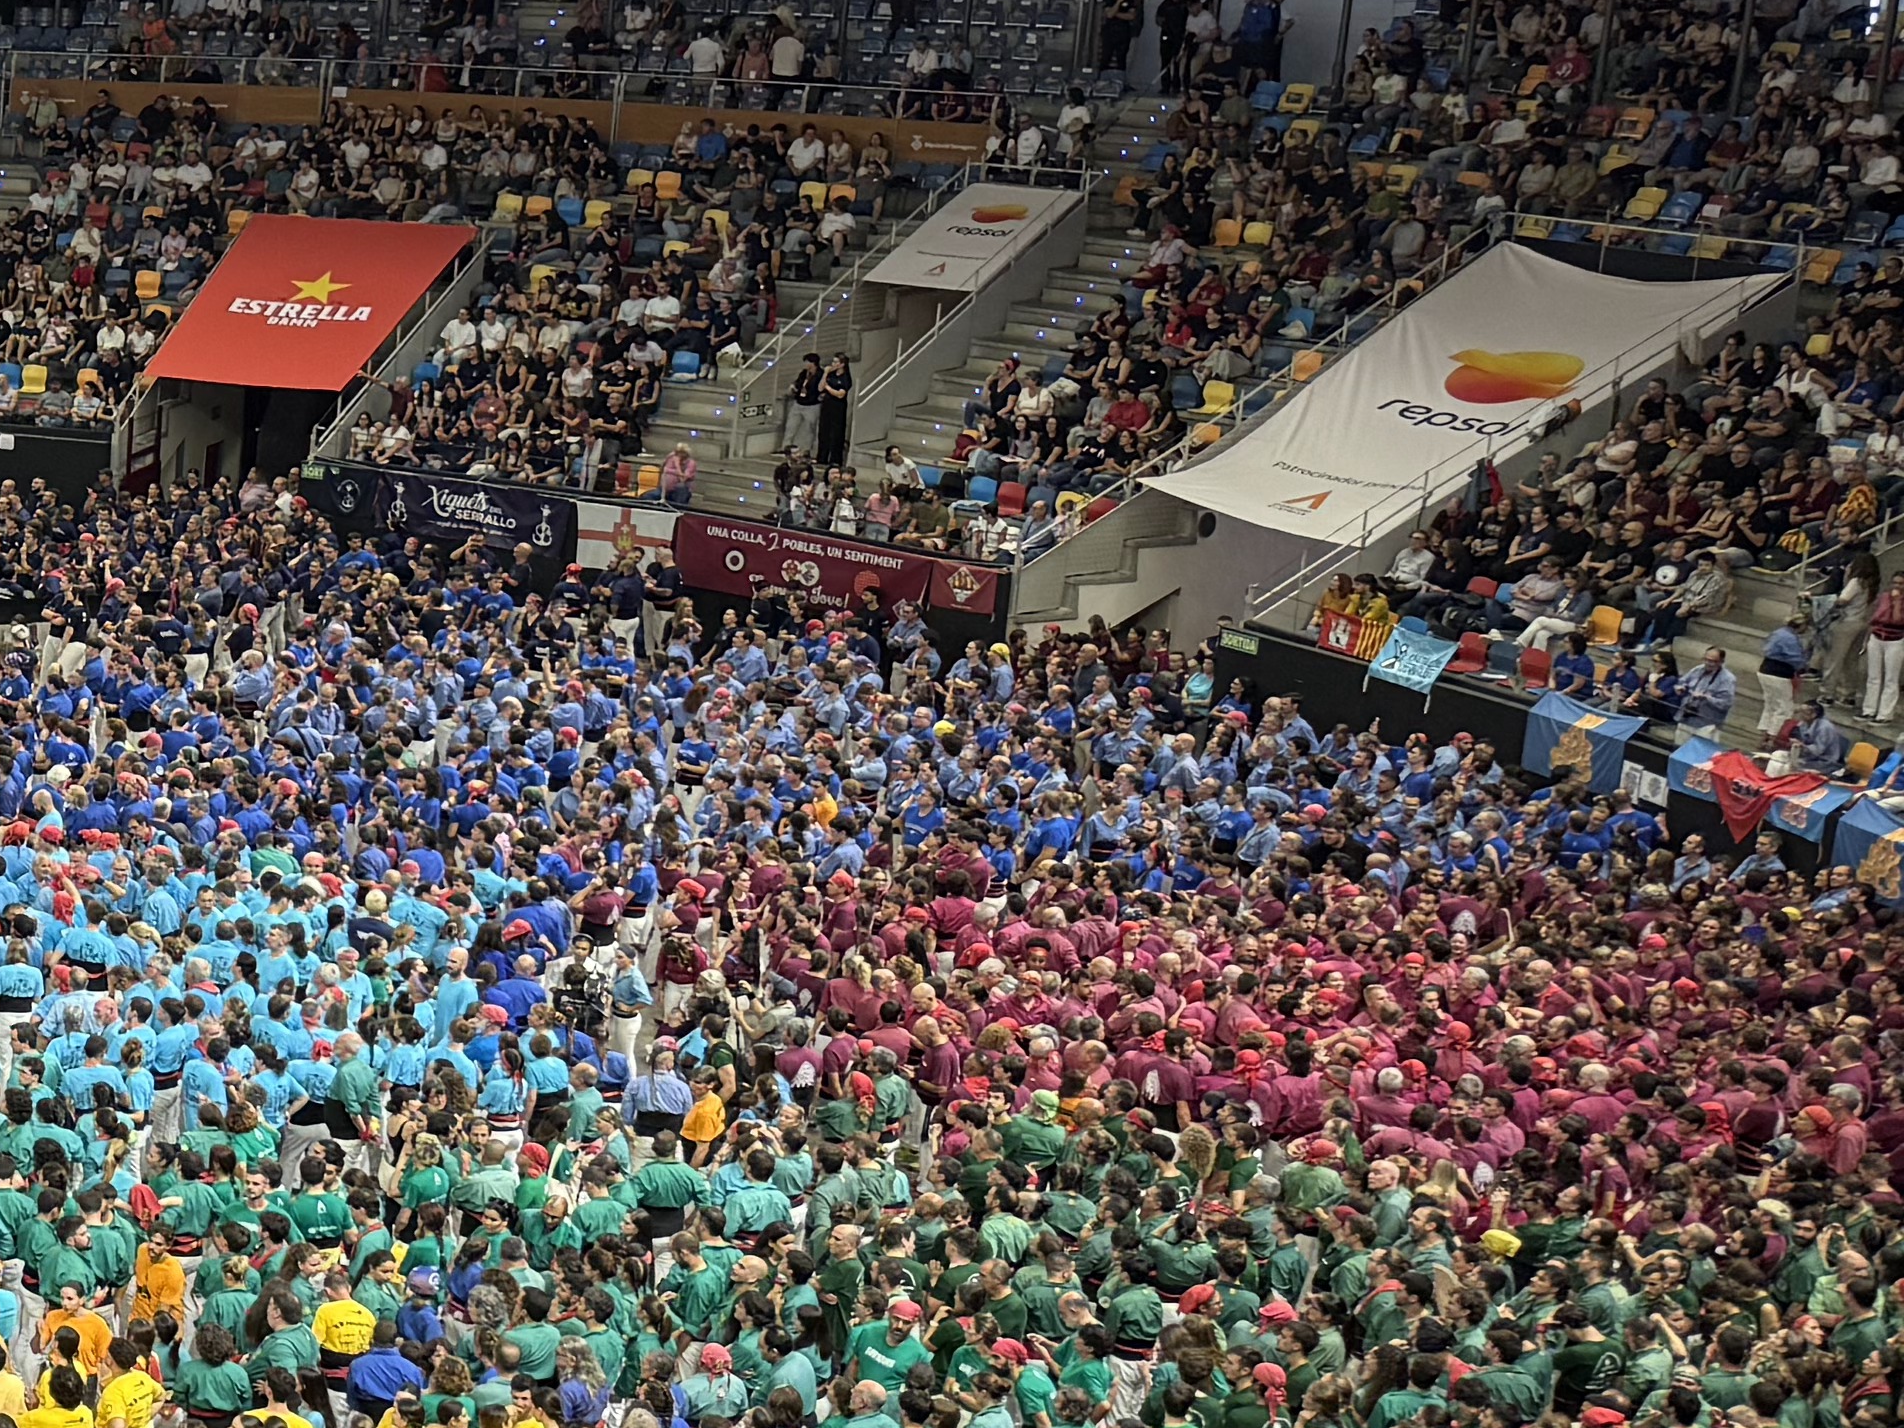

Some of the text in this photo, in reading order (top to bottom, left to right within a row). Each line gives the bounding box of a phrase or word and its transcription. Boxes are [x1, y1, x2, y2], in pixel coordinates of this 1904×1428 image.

[947, 226, 1014, 239] repsol
[228, 297, 372, 322] ESTRELLA
[266, 316, 319, 328] DAMM
[1377, 396, 1528, 439] repsol
[1273, 460, 1364, 486] Patrocinador
[454, 509, 517, 529] SERRALLO
[707, 525, 729, 539] UNA
[827, 546, 842, 559] UN
[844, 549, 904, 570] SENTIMENT
